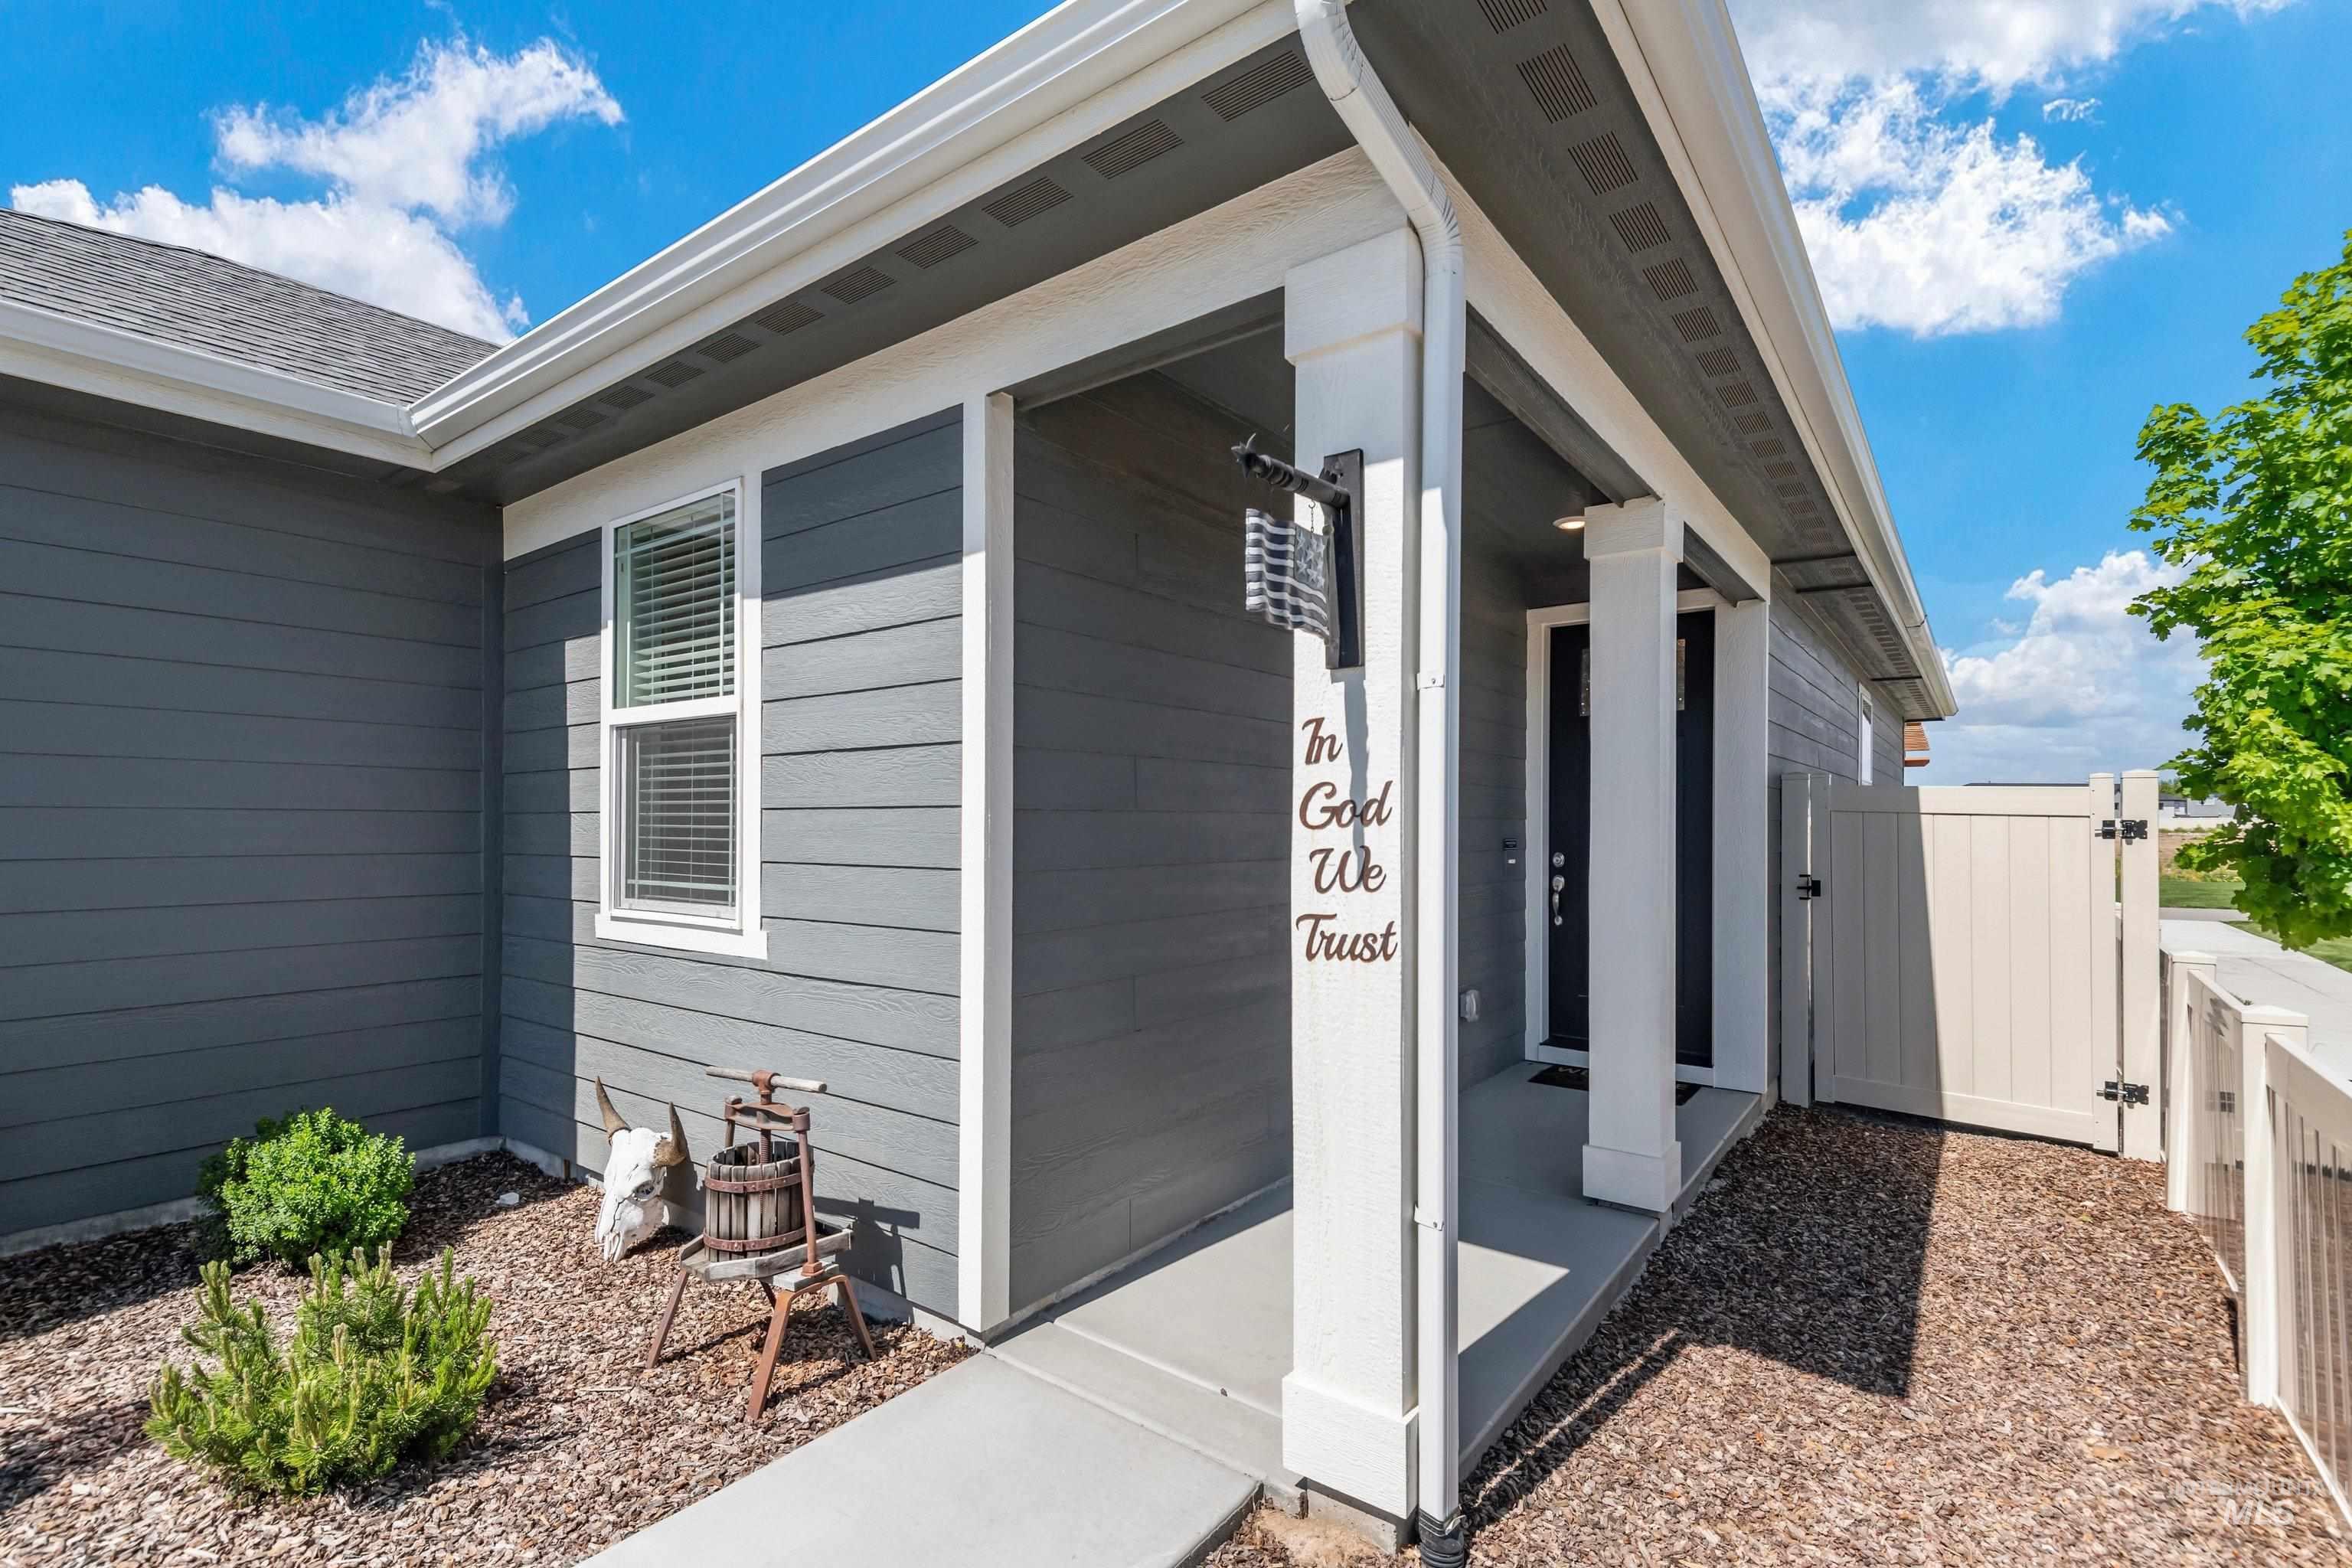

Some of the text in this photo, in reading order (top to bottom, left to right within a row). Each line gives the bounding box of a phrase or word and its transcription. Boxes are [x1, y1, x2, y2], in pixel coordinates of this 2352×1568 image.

[1302, 717, 1343, 766] In
[1299, 780, 1393, 830] God
[1309, 845, 1387, 894] We
[1295, 913, 1398, 963] Trust
